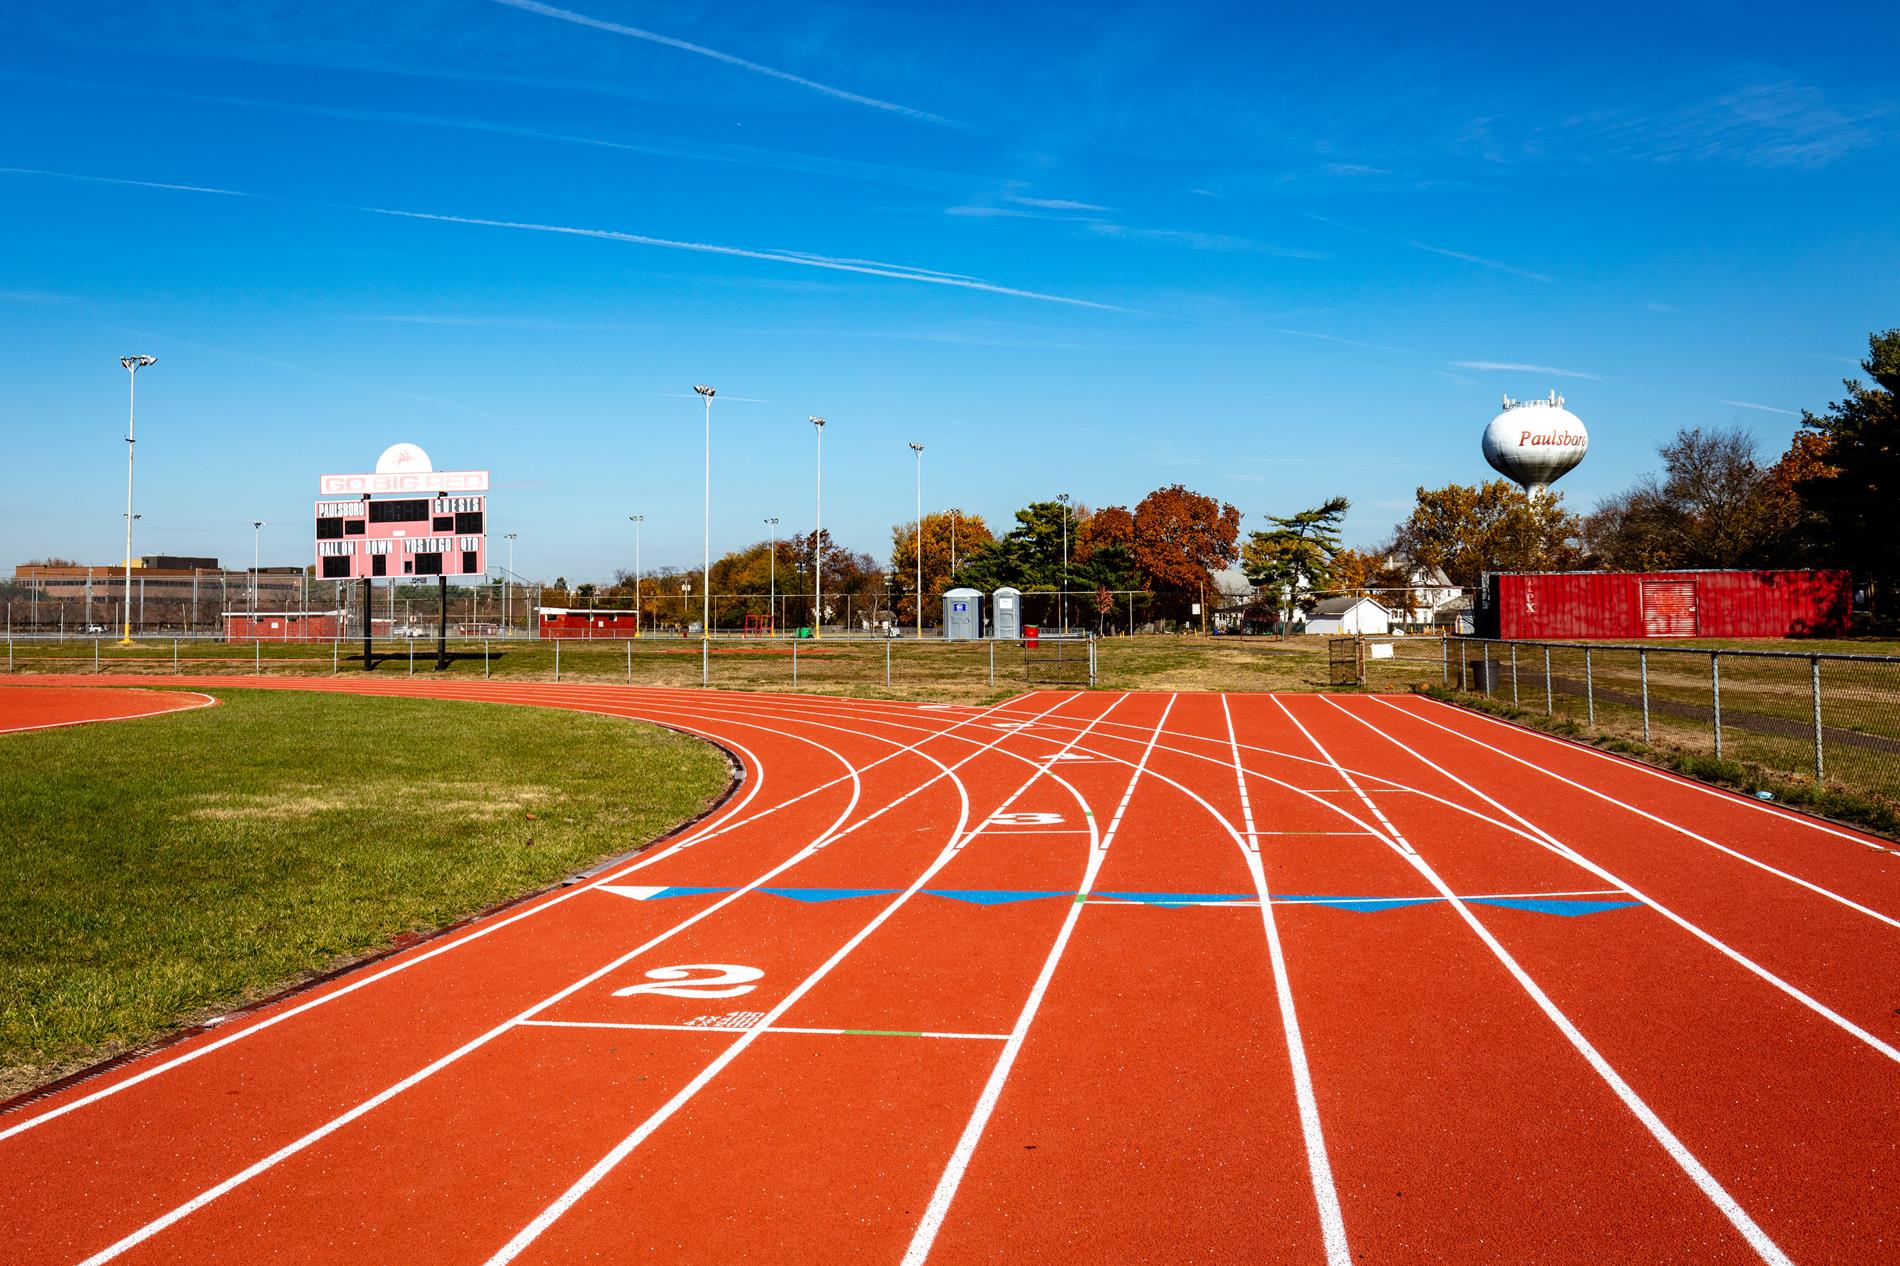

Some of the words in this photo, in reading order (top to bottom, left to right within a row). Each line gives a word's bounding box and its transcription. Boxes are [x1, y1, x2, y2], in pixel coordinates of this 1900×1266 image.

[1519, 430, 1587, 447] Paulsboro
[325, 477, 367, 491] GO
[373, 475, 418, 490] BIG
[425, 474, 483, 489] RED
[318, 502, 365, 518] PAULSBORO
[434, 498, 480, 513] GUESTS
[319, 541, 340, 556] BALL
[341, 541, 355, 555] ON
[365, 540, 393, 554] DOWN
[404, 538, 423, 553] YDS
[425, 538, 437, 552] TO
[438, 537, 452, 552] GO
[460, 537, 480, 552] QTR
[989, 812, 1065, 825] 3
[611, 964, 765, 999] 2
